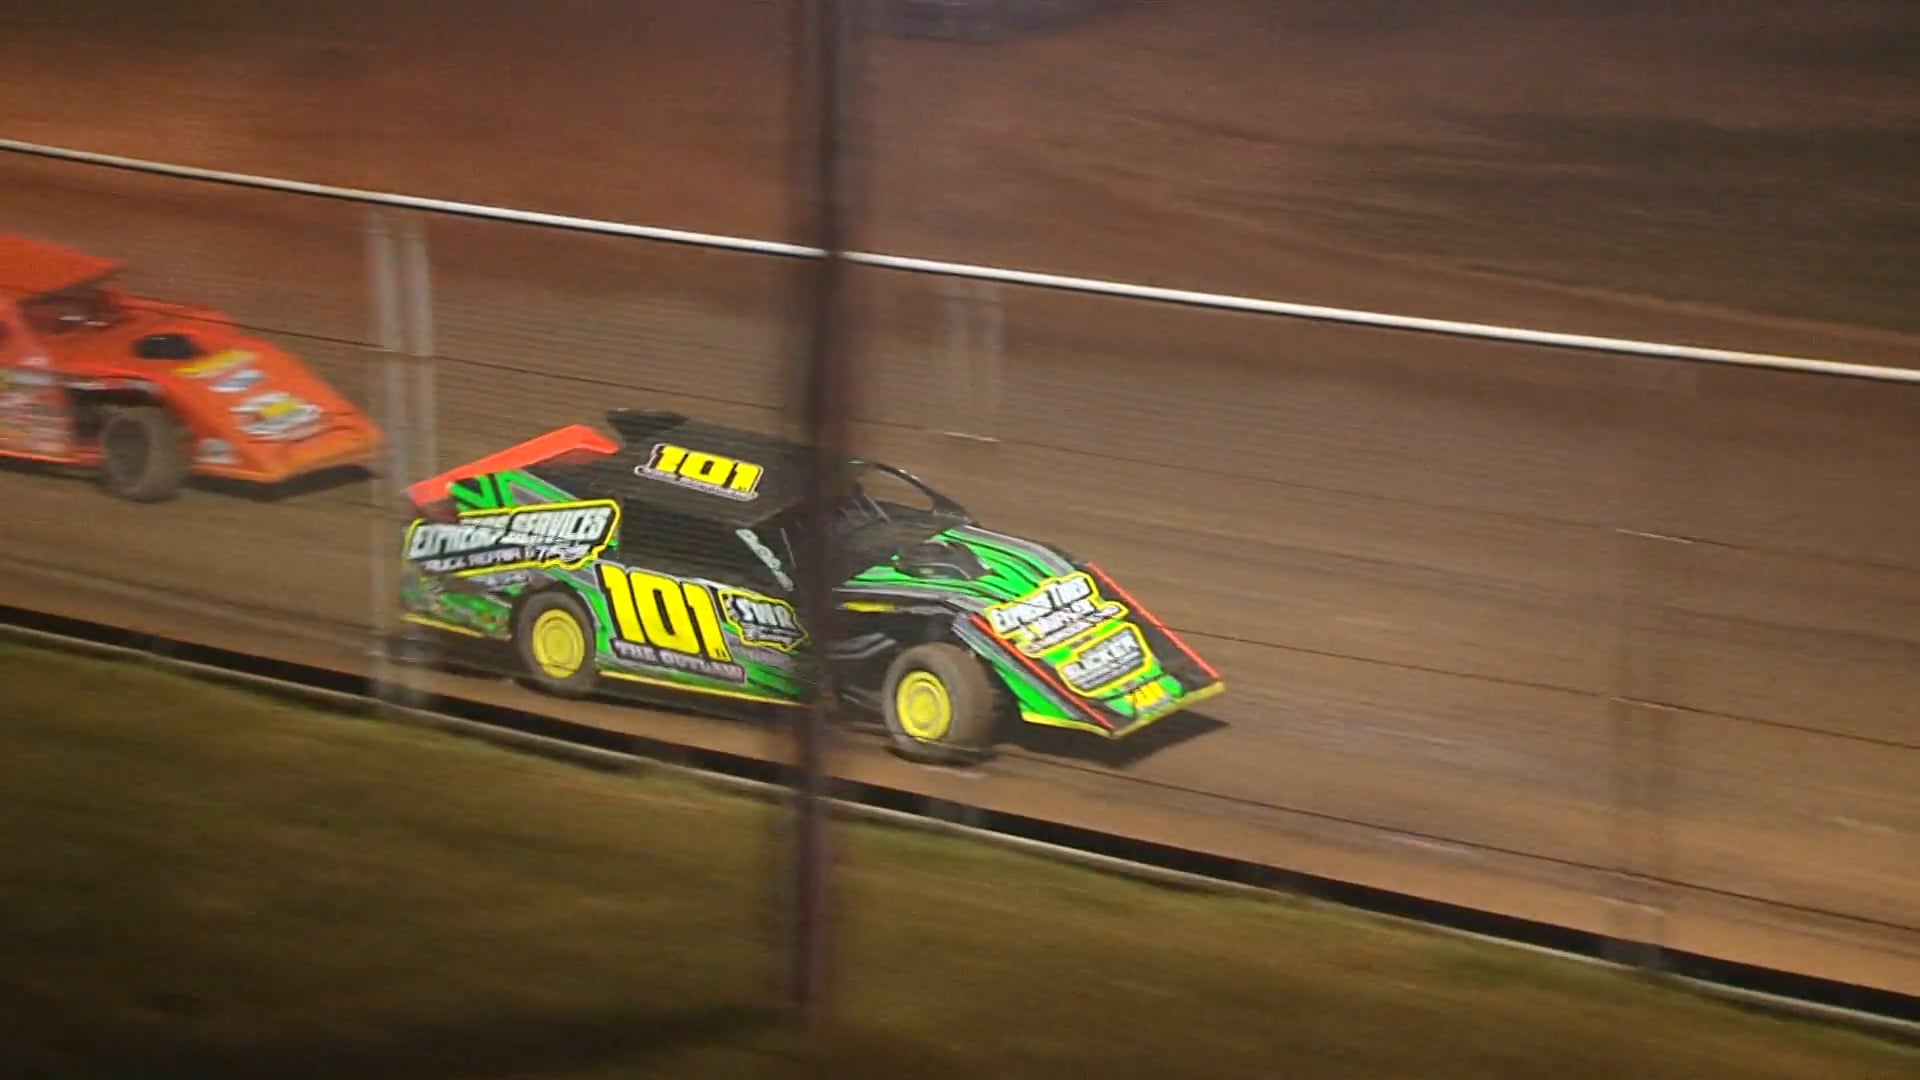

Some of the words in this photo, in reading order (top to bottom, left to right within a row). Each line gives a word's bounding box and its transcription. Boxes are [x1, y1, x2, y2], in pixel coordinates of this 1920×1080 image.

[656, 445, 760, 493] 101
[501, 507, 612, 546] SERVICES
[601, 565, 733, 663] 101
